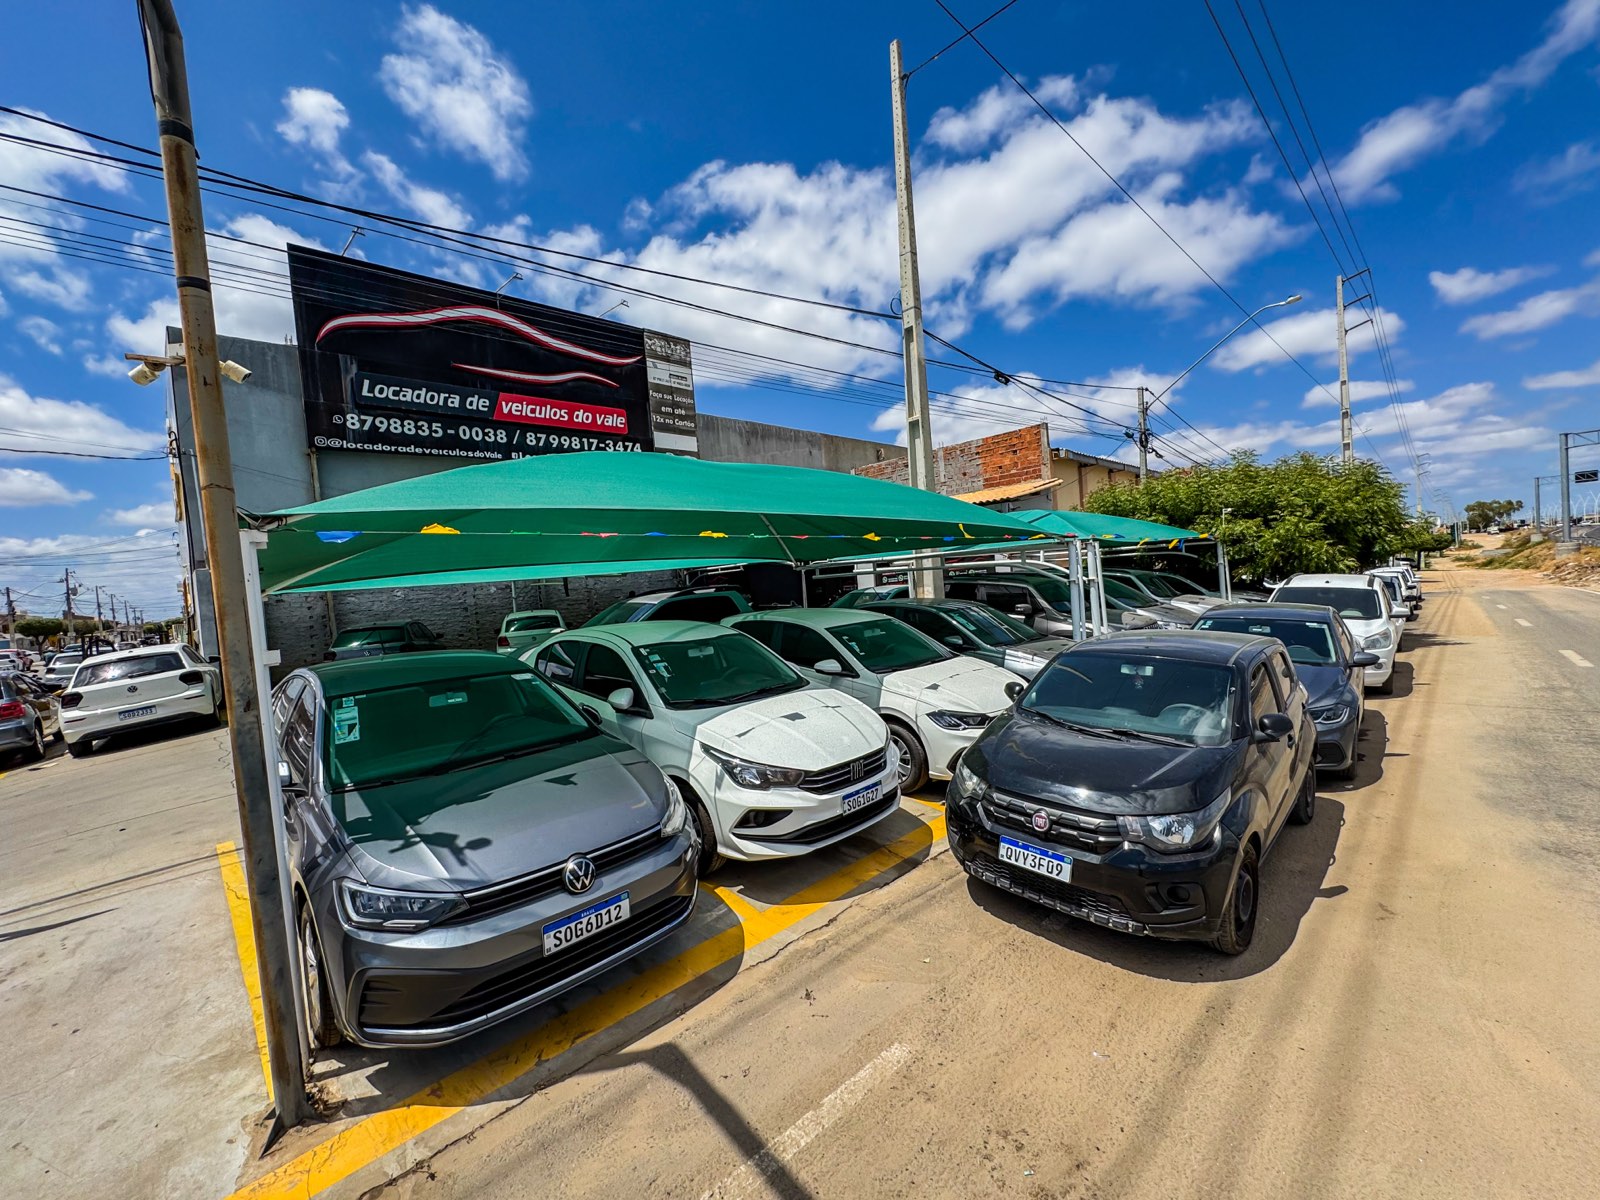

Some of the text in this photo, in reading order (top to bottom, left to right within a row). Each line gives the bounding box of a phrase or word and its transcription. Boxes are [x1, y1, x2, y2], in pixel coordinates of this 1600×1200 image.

[361, 379, 460, 408] Locadora
[466, 395, 490, 411] de
[573, 409, 593, 424] do
[596, 413, 626, 428] vale
[553, 904, 623, 949] SOG6D12
